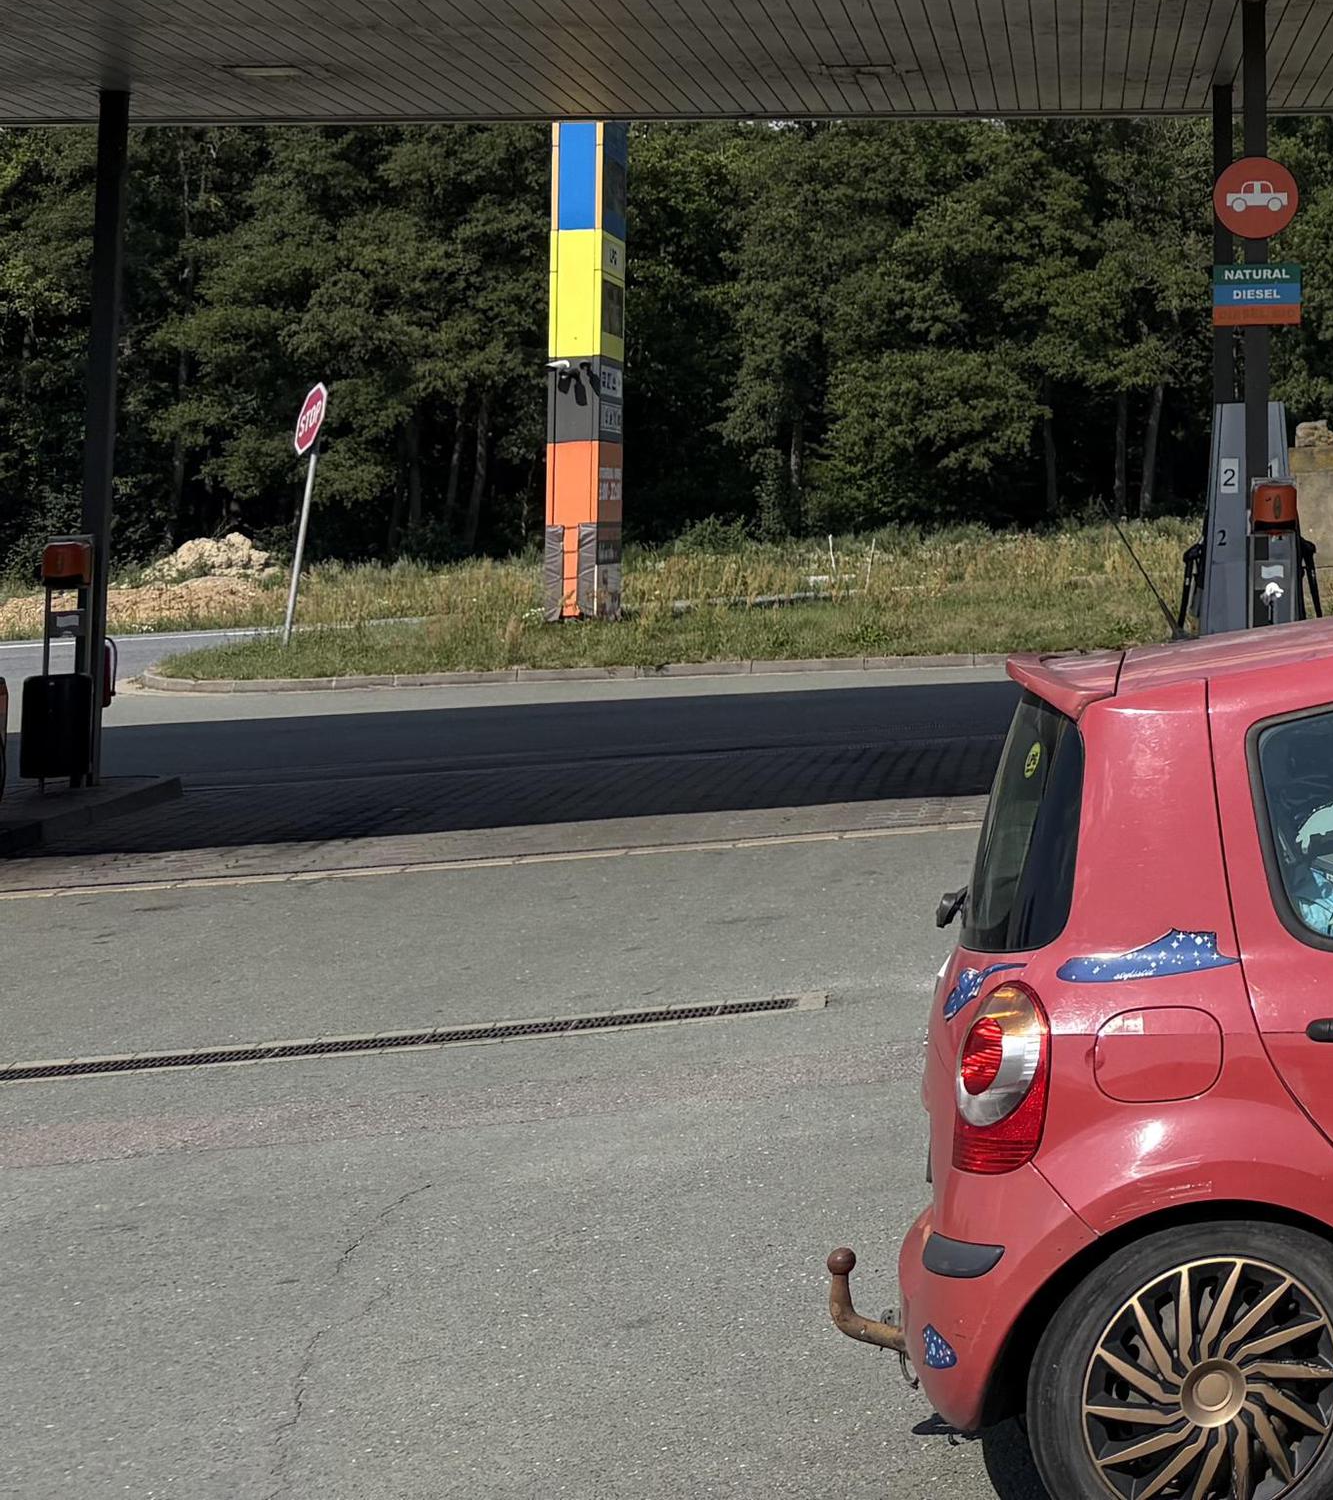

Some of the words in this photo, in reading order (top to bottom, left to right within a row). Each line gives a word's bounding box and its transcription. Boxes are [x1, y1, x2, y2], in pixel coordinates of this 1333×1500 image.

[1224, 268, 1290, 280] NATURAL
[1233, 289, 1281, 300] DIESEL
[299, 400, 322, 437] STOP
[1223, 468, 1236, 486] 2
[1217, 529, 1227, 547] 2
